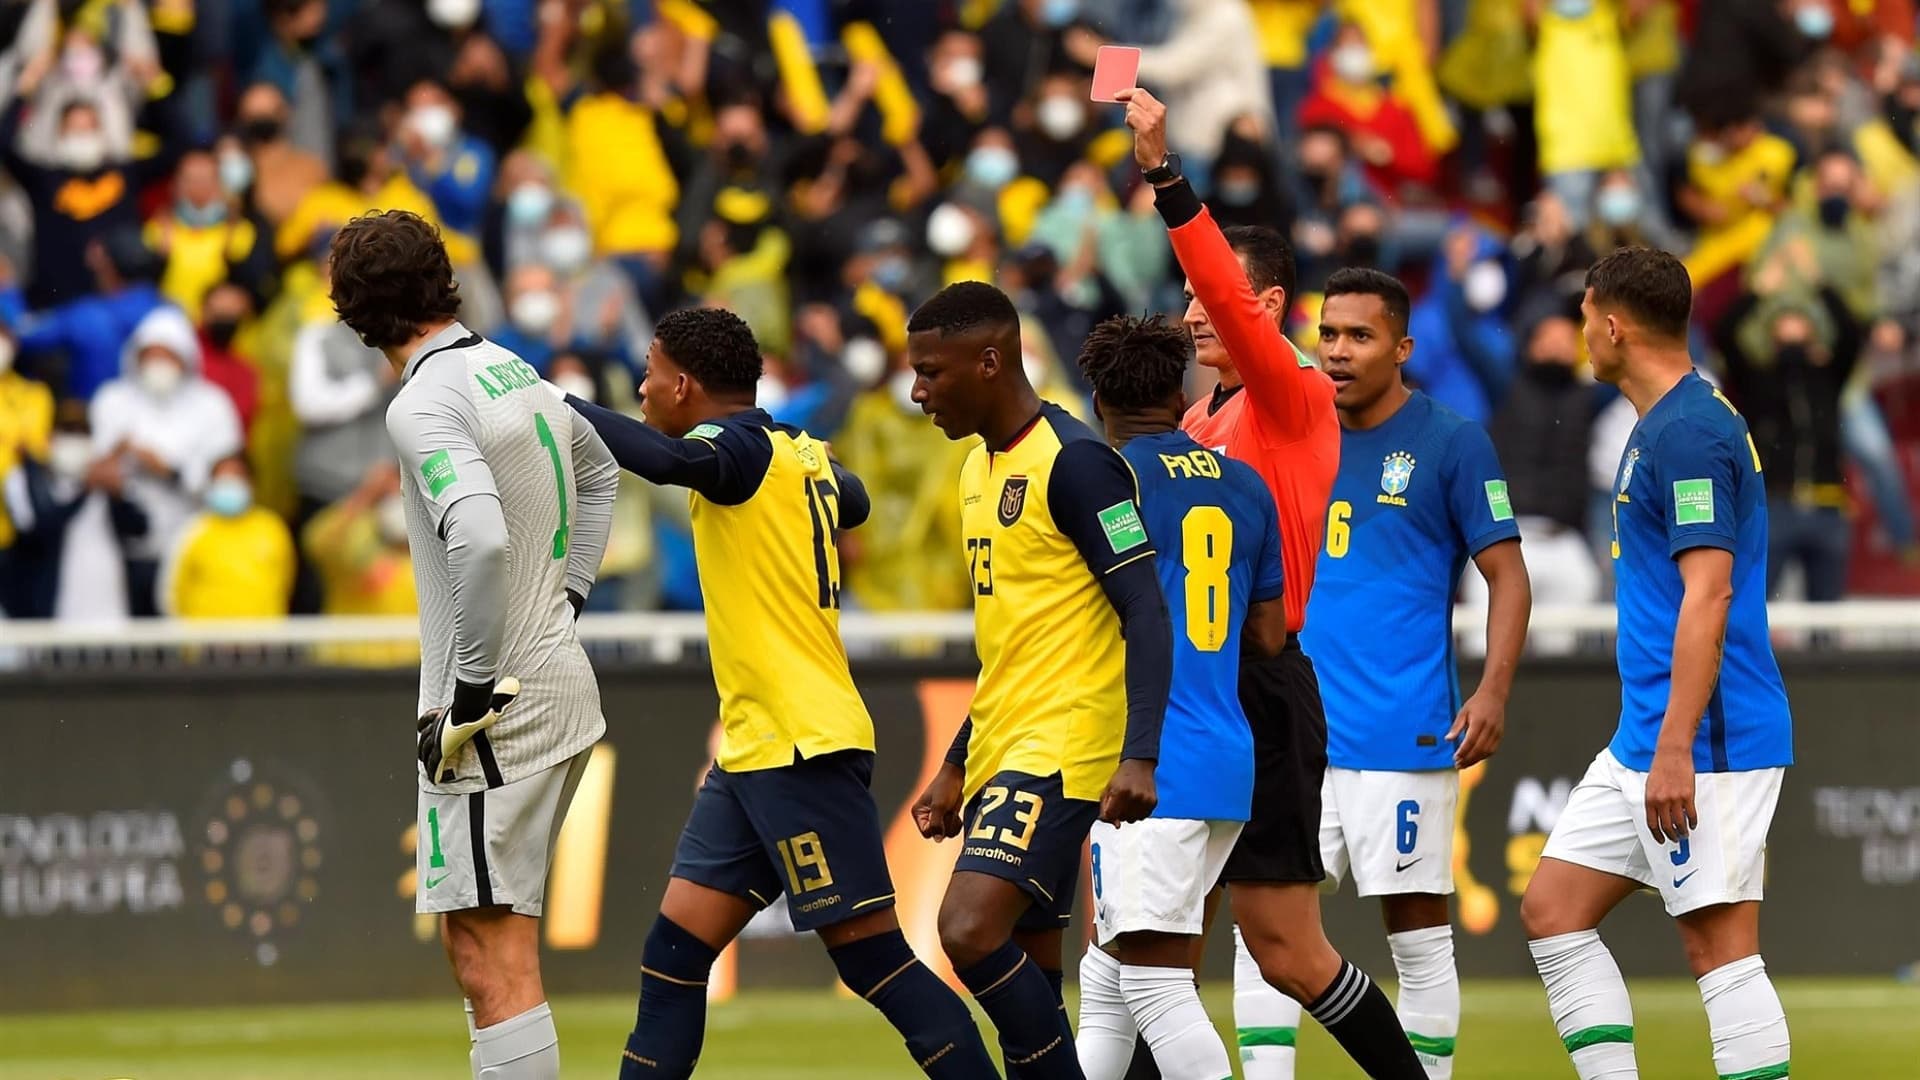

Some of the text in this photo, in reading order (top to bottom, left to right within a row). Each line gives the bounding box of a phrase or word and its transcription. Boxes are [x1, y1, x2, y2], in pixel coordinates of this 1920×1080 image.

[534, 412, 569, 560] 1
[1158, 450, 1222, 480] FRED
[1326, 501, 1352, 558] 6
[1376, 494, 1407, 506] BRASIL
[1182, 506, 1233, 652] 8
[428, 807, 445, 868] 1
[969, 786, 1044, 850] 23
[1396, 799, 1420, 854] 6
[776, 831, 834, 896] 19
[965, 846, 1022, 866] marathon
